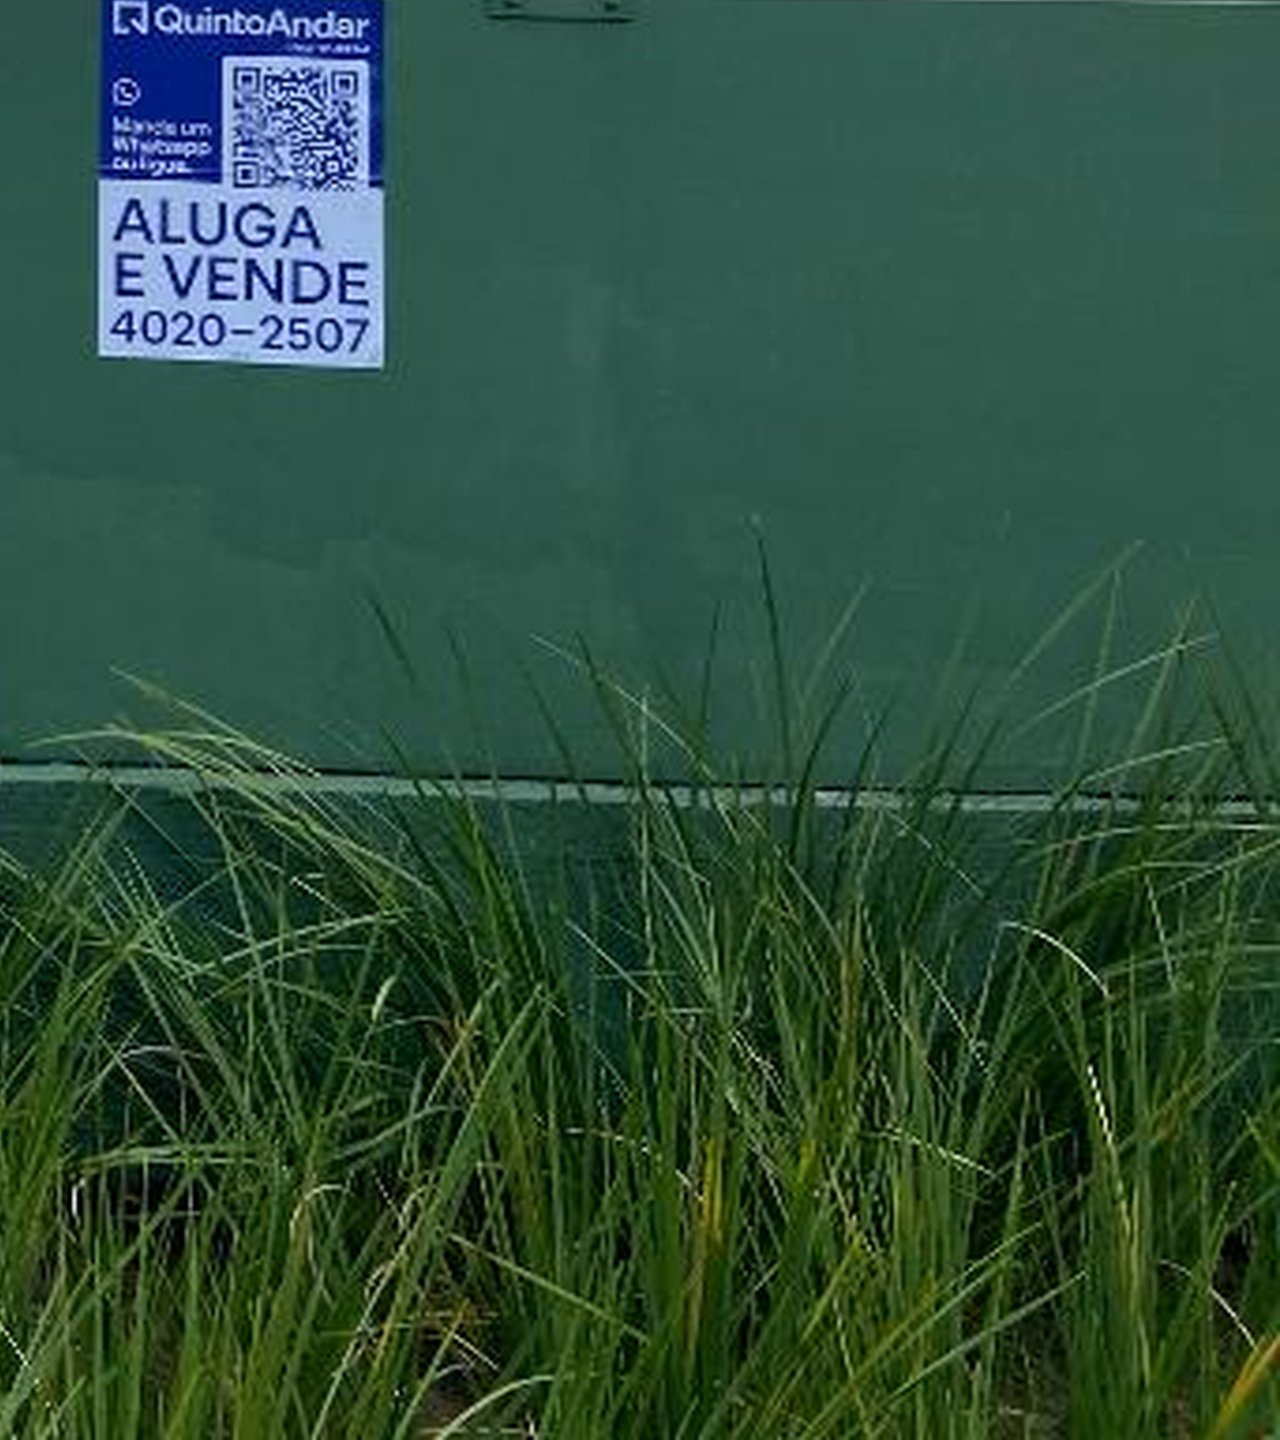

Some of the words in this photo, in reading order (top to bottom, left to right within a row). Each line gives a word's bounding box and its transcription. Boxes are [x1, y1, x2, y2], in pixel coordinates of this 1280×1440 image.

[154, 4, 371, 40] QuintoAndar
[180, 122, 213, 137] um
[113, 198, 323, 252] ALUGA
[114, 252, 145, 298] E
[162, 254, 370, 308] VENDE
[110, 310, 371, 354] 4020-2507
